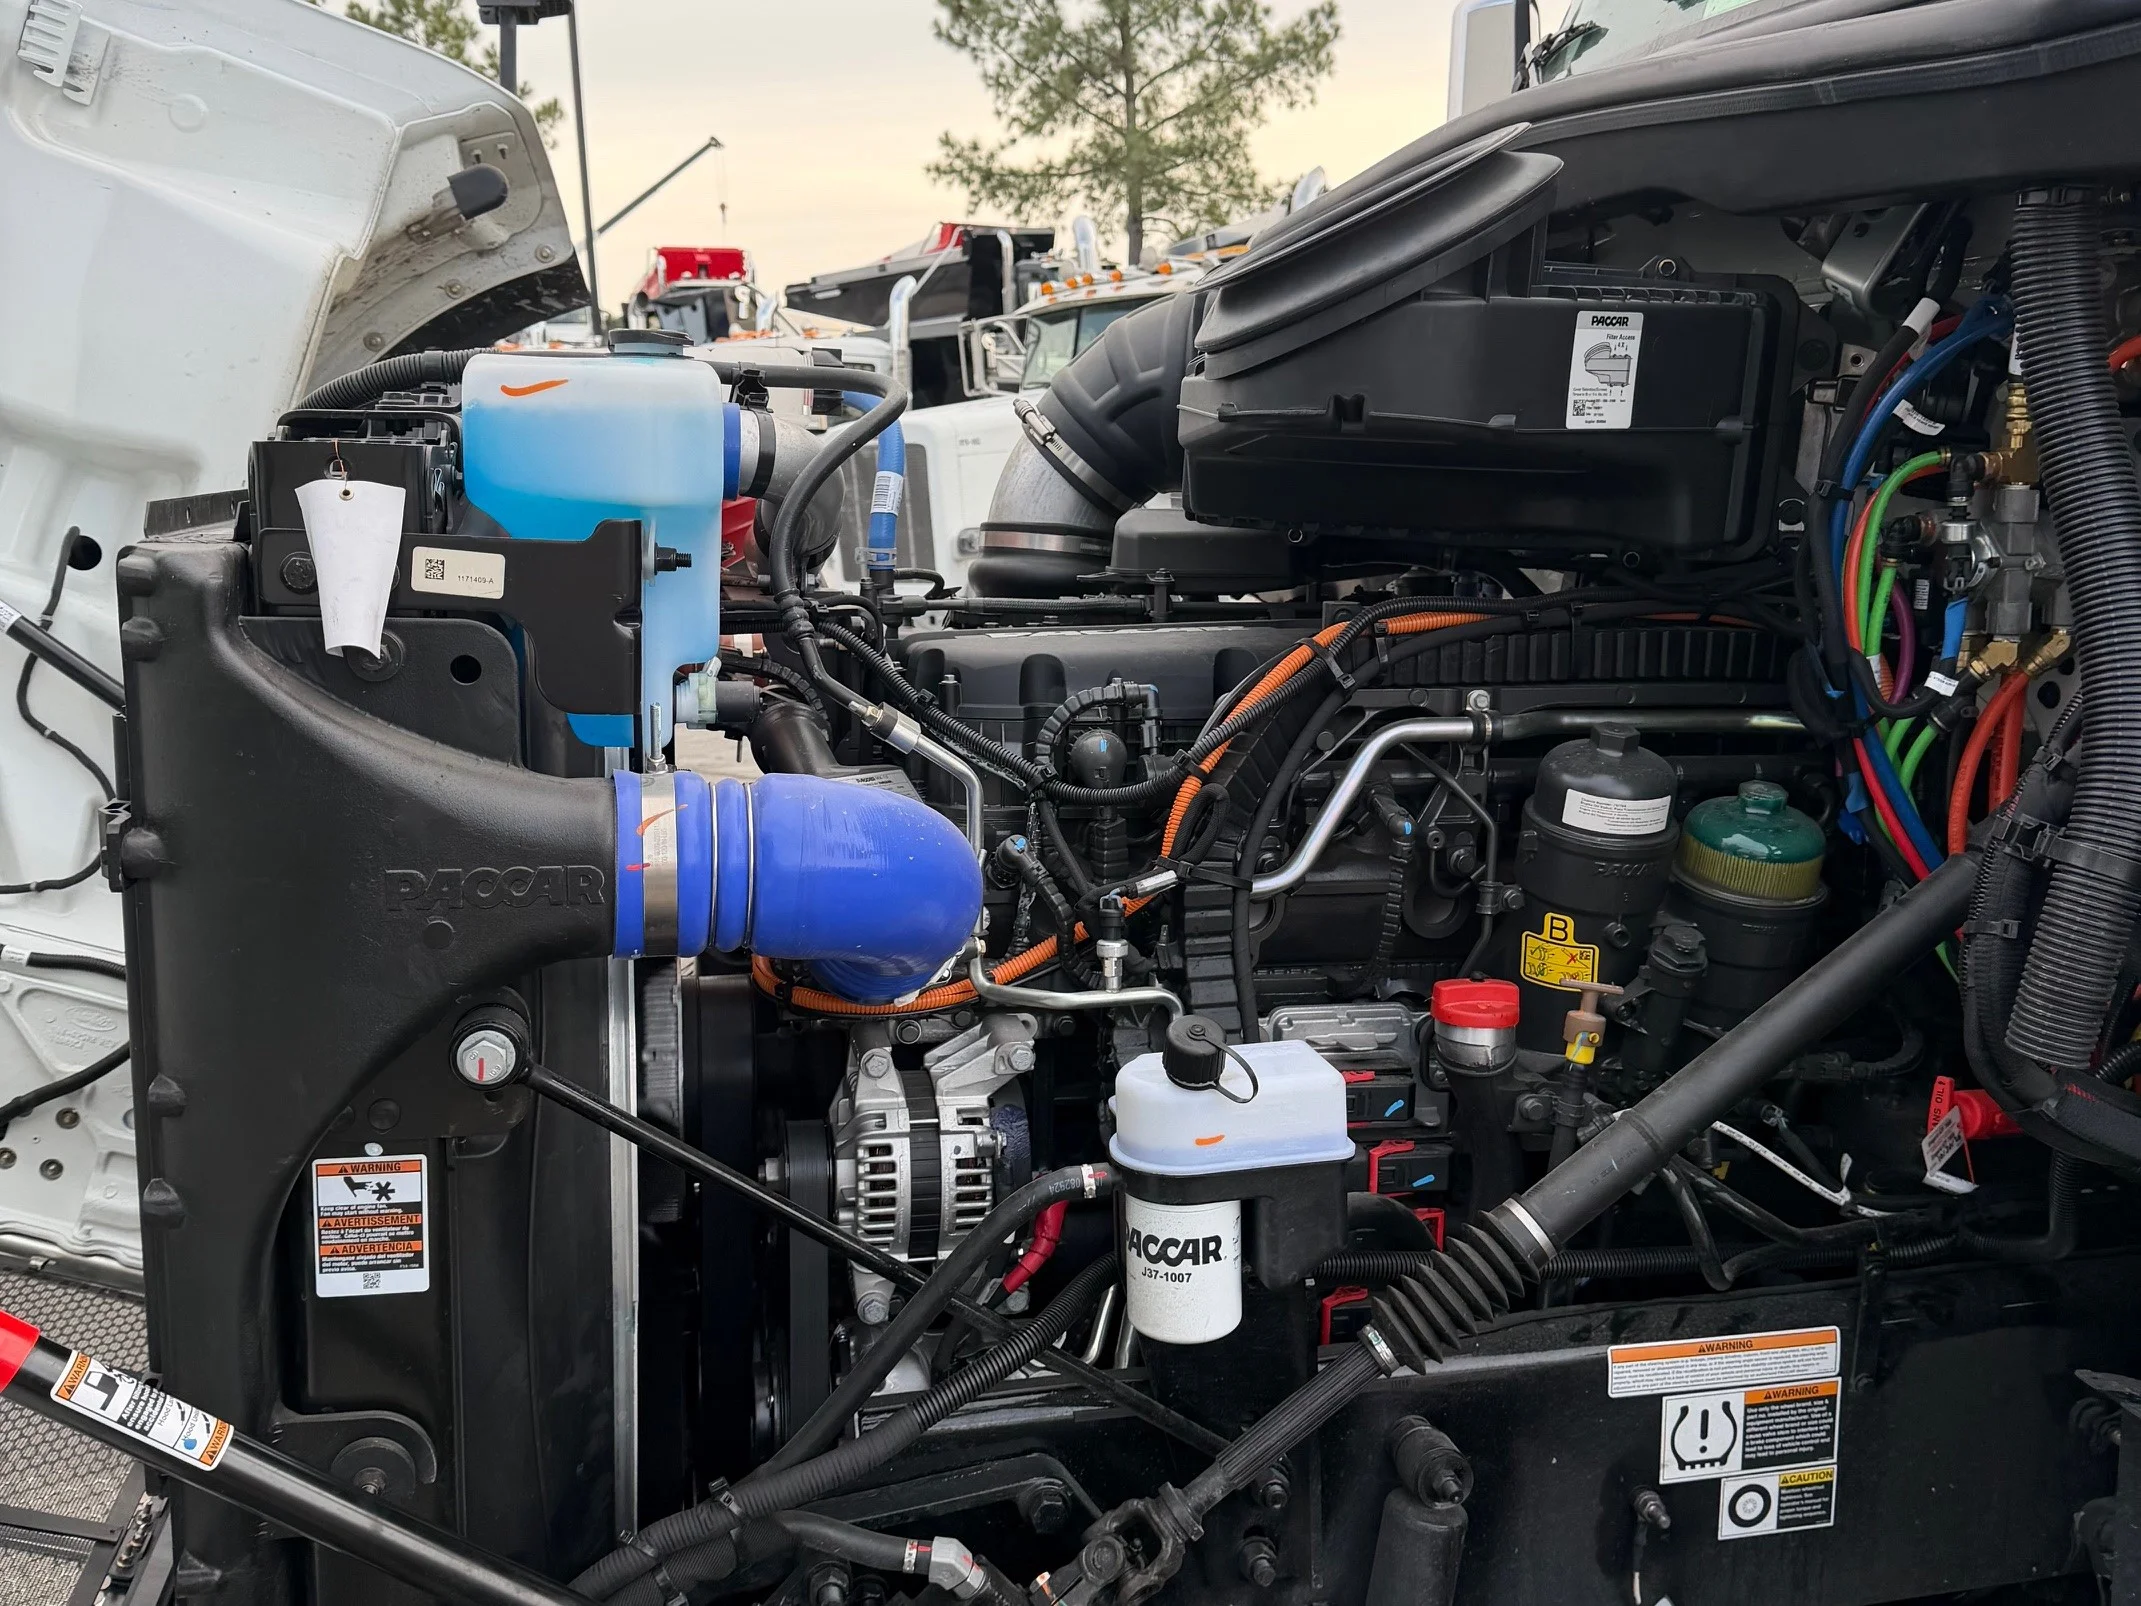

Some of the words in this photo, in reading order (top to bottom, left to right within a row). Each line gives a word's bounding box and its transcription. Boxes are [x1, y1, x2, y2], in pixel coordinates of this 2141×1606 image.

[1591, 316, 1629, 326] PACCAR
[458, 576, 494, 584] 1171409-A
[385, 865, 605, 911] PACCAR
[1549, 916, 1568, 941] B
[1935, 1090, 1944, 1104] OIL
[350, 1163, 401, 1173] WARNING
[334, 1215, 419, 1227] AVERTISSEMENT
[342, 1242, 412, 1253] ADVERTENCIA
[1126, 1220, 1222, 1267] ACCAR
[1142, 1266, 1192, 1283] J37-1007
[1704, 1340, 1753, 1352] WARNING
[1773, 1386, 1819, 1399] WARNING
[122, 1400, 136, 1420] After
[127, 1400, 146, 1427] ensure
[135, 1398, 155, 1430] engaged
[158, 1407, 171, 1427] Hood
[1790, 1471, 1833, 1483] CAUTION
